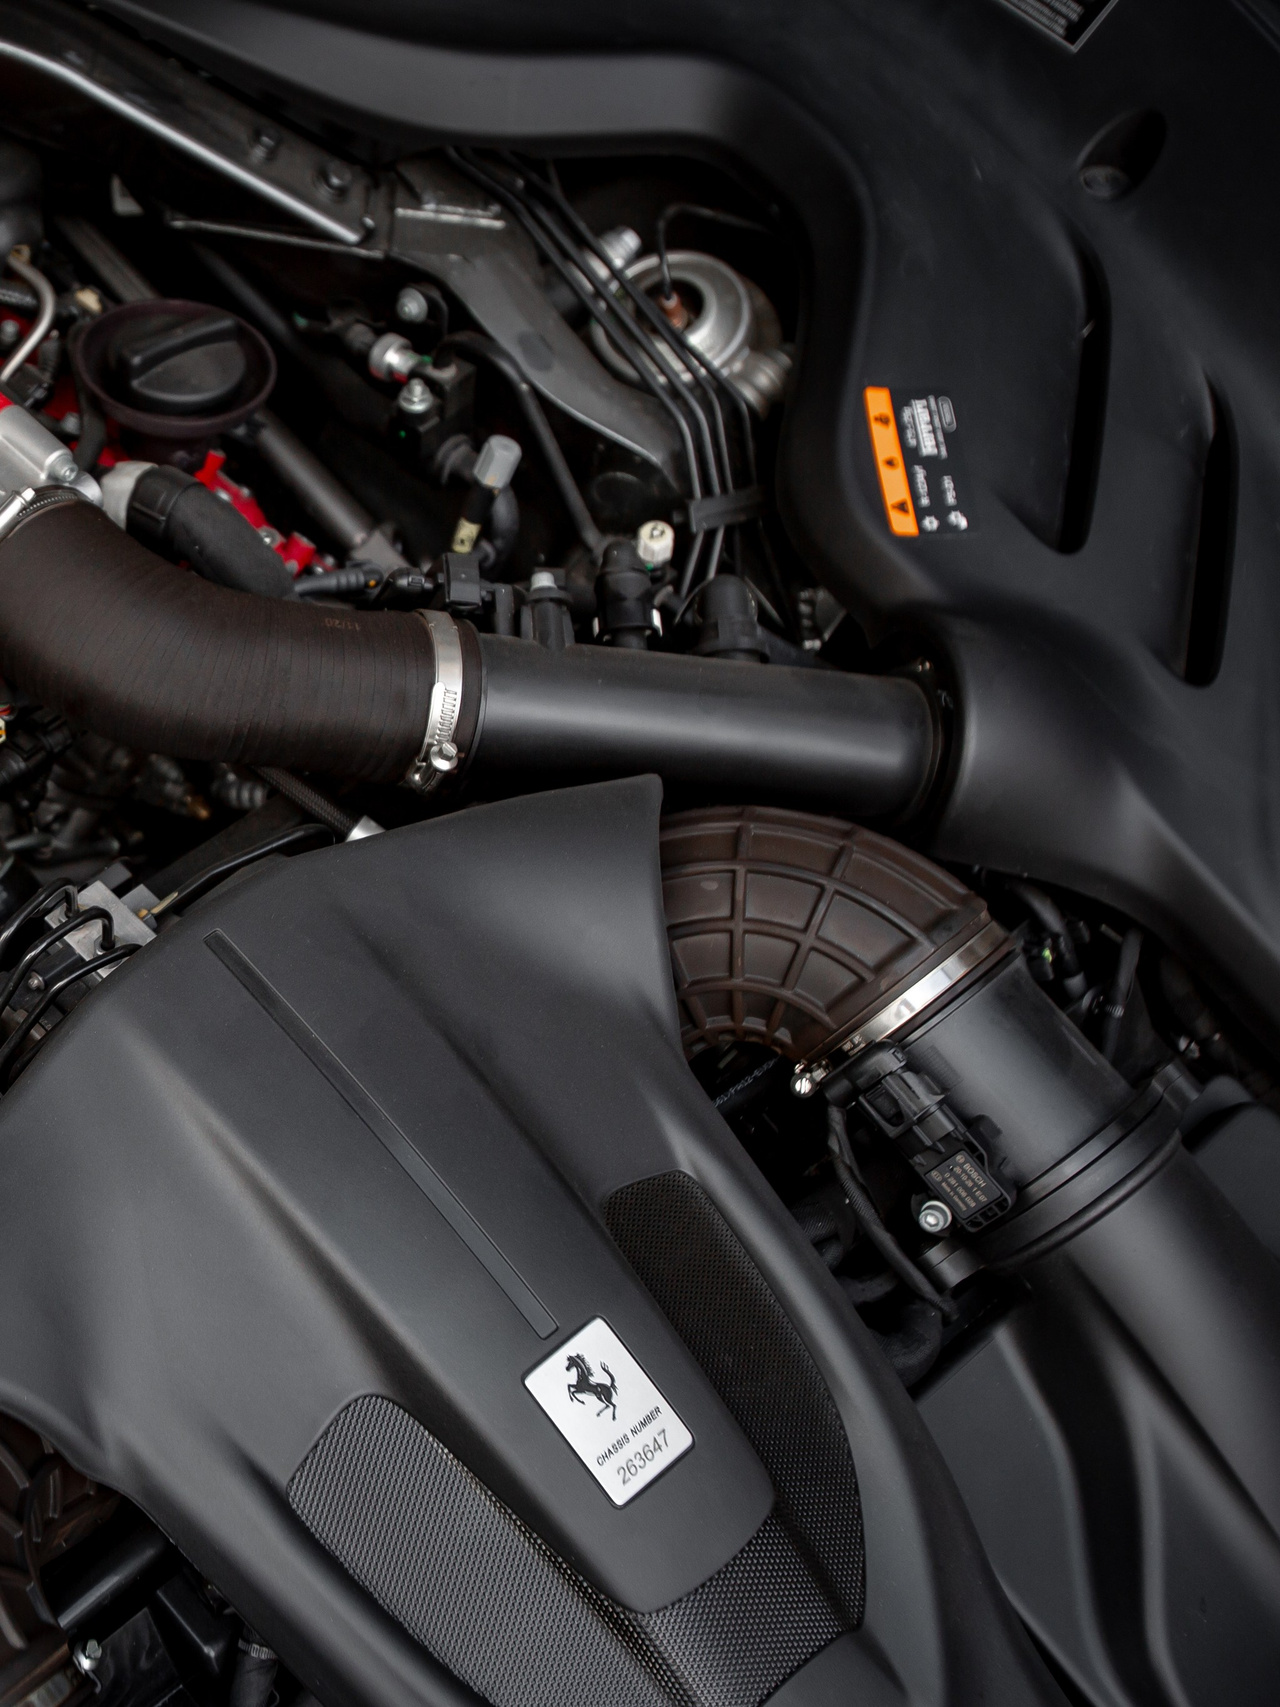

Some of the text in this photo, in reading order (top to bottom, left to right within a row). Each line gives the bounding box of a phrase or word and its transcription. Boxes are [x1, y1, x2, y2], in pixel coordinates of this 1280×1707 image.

[963, 1162, 987, 1188] BOSCH
[596, 1406, 662, 1467] CHASSIS NUMBER
[617, 1429, 669, 1485] 263647
